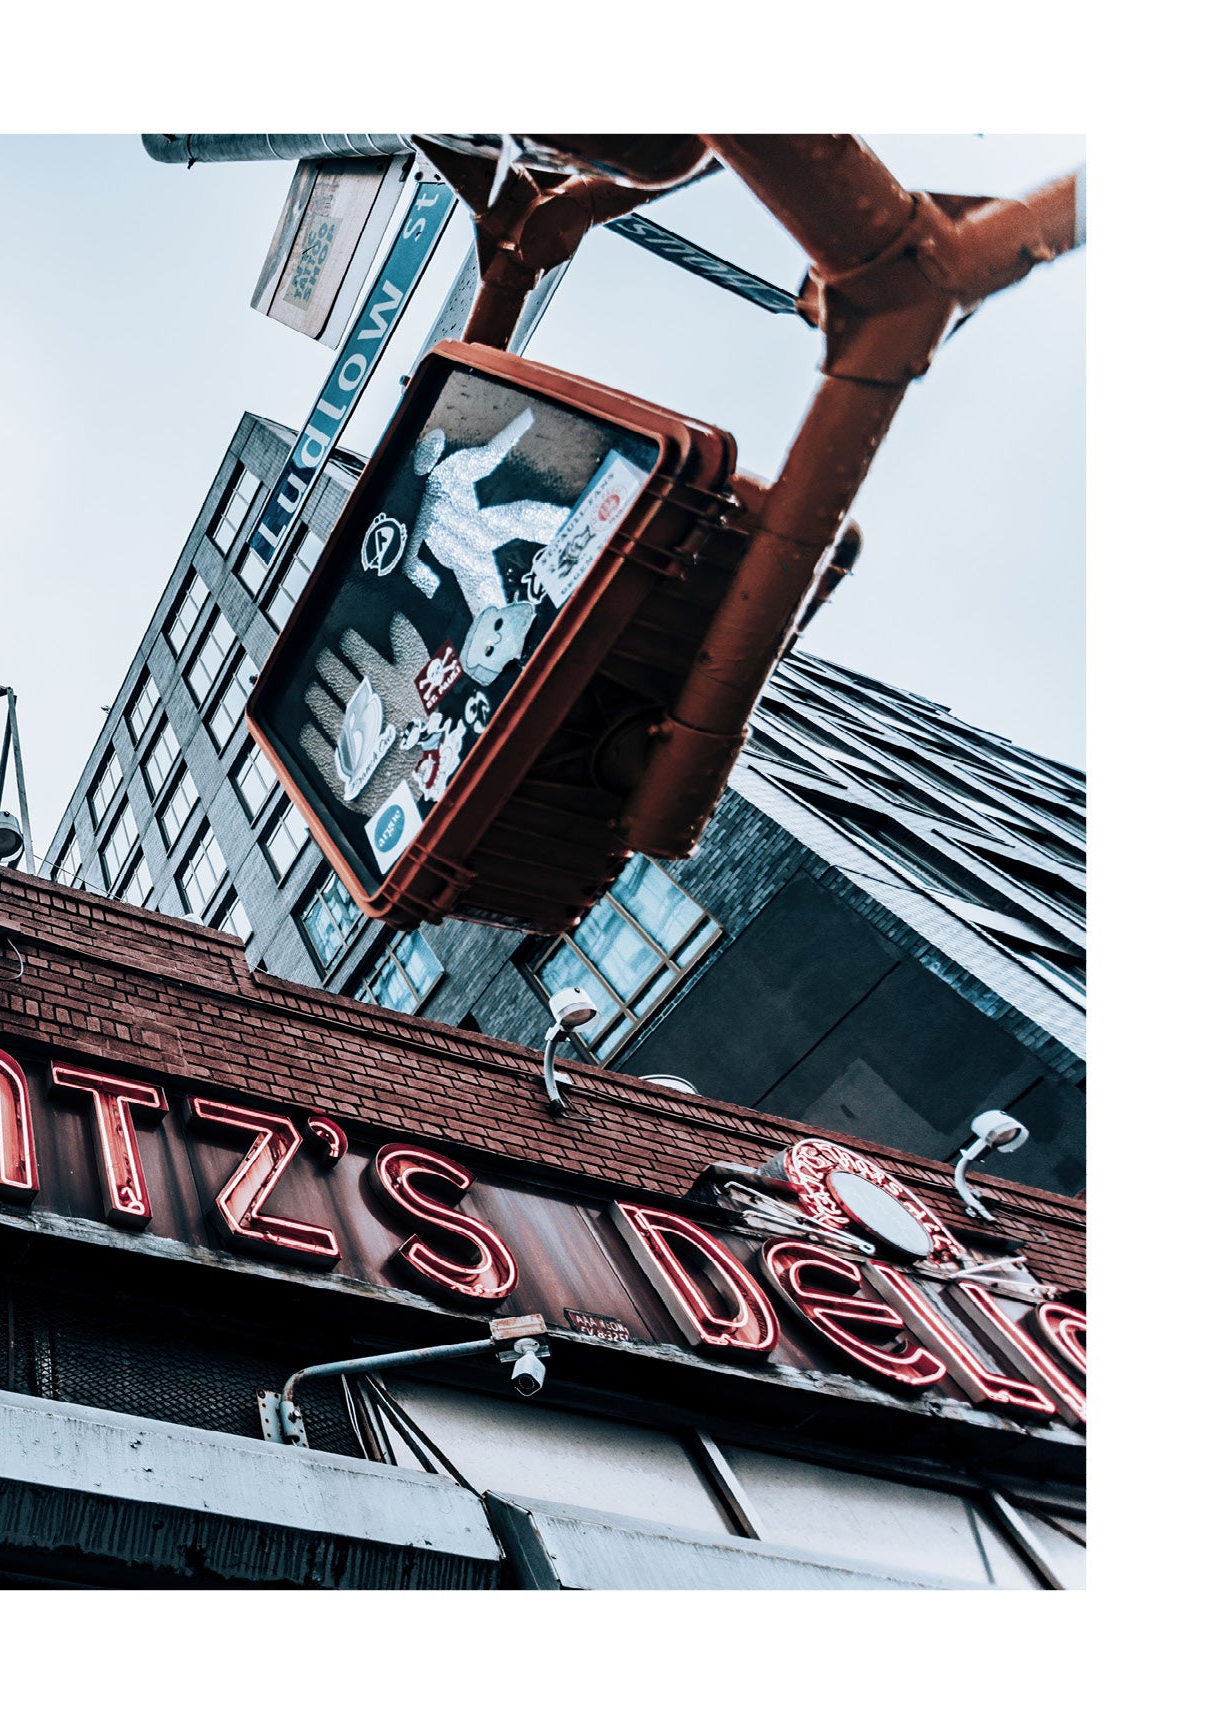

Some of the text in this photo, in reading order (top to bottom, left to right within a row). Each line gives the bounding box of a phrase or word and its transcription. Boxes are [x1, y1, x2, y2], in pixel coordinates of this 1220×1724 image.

[294, 222, 328, 299] TATTOO
[302, 224, 336, 302] SHOP
[253, 279, 405, 552] Ludlow
[438, 664, 462, 695] PAULI
